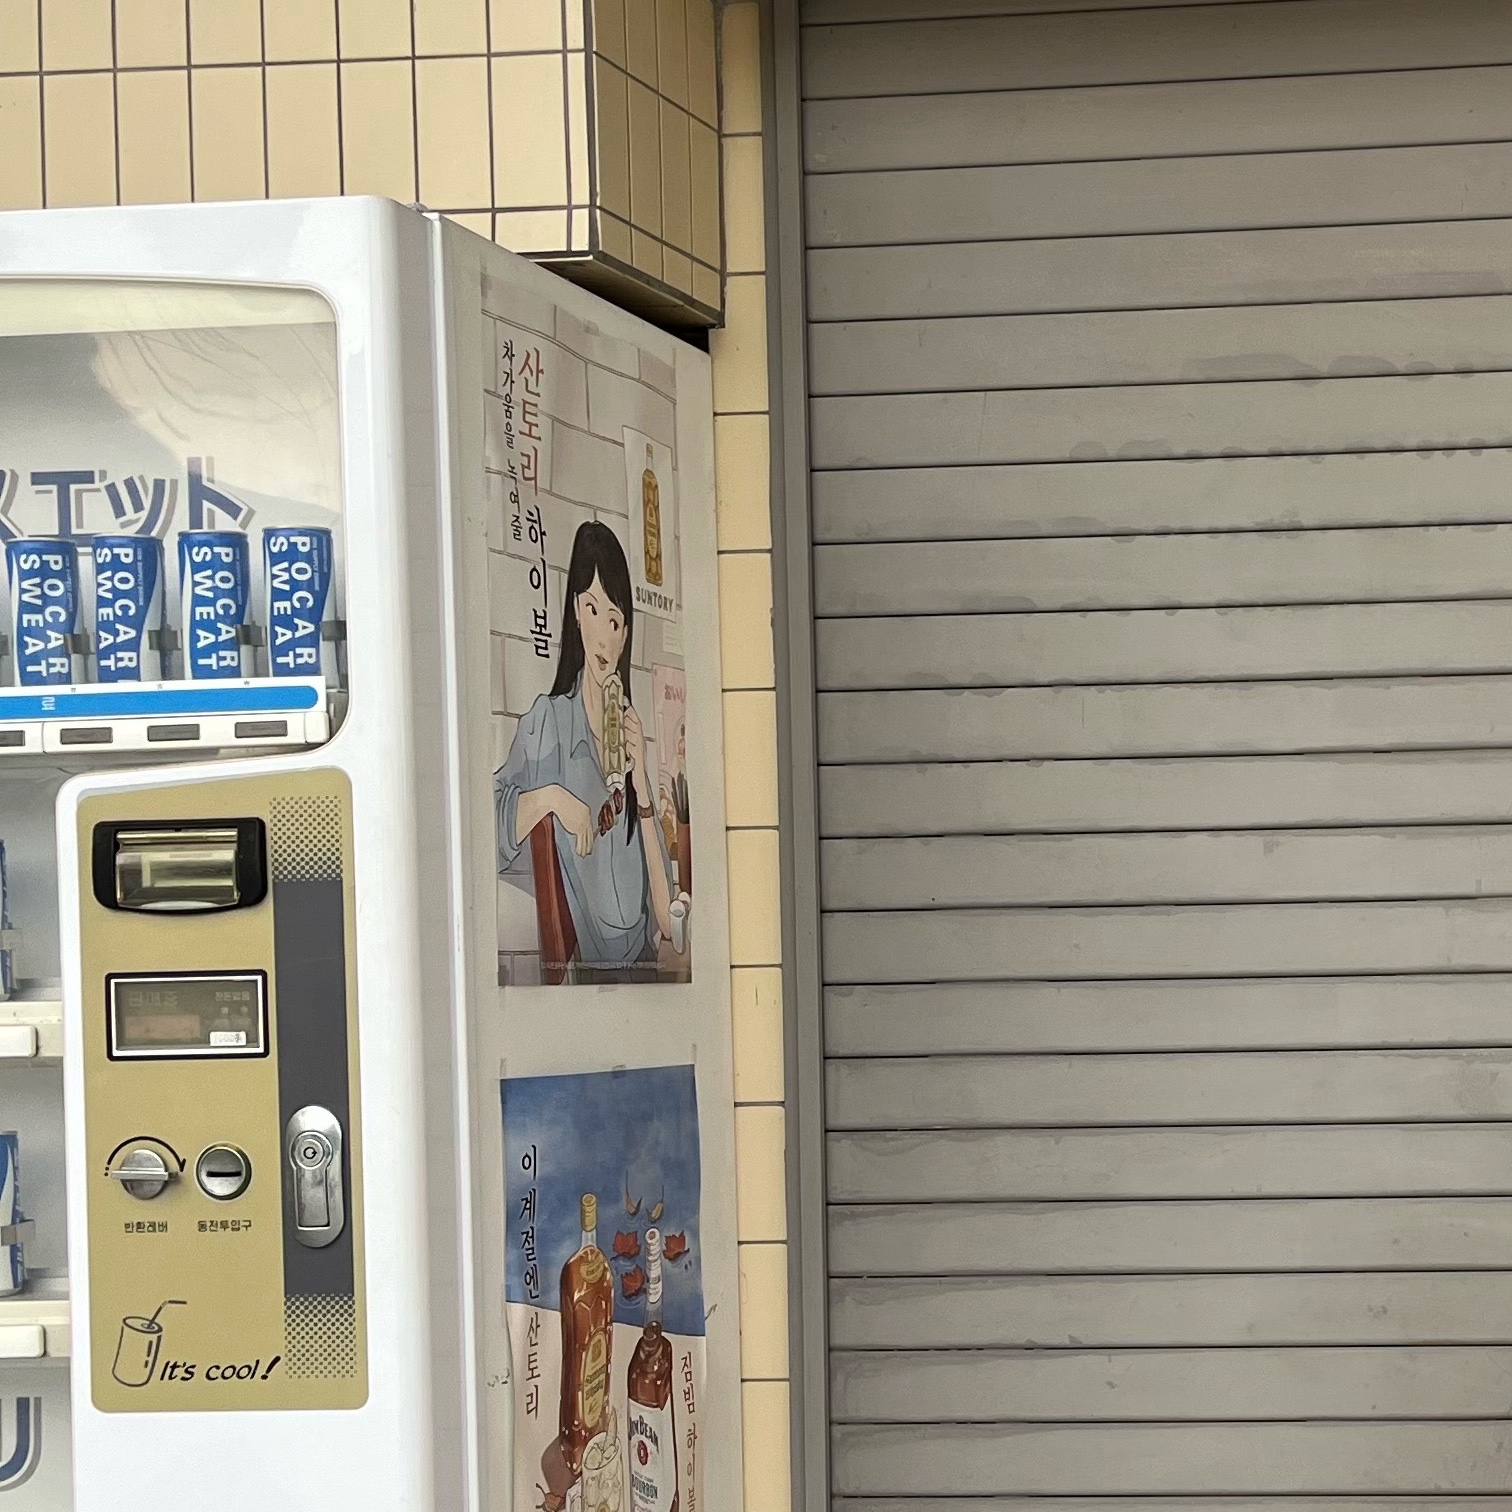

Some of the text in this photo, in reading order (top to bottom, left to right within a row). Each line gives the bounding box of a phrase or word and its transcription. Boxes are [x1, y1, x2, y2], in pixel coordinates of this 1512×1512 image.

[502, 339, 515, 450] 차가움을
[518, 346, 553, 659] 산토리 하이볼
[19, 553, 48, 678] SWEAT
[96, 547, 116, 672] SWEAT
[112, 547, 138, 682] POCAR
[191, 546, 218, 671] SWEAT
[269, 535, 295, 669] SWEAT
[635, 586, 674, 613] SUNTORY
[197, 1219, 252, 1233] 동전투입구
[160, 1360, 197, 1381] It's
[525, 1312, 541, 1421] 산토리
